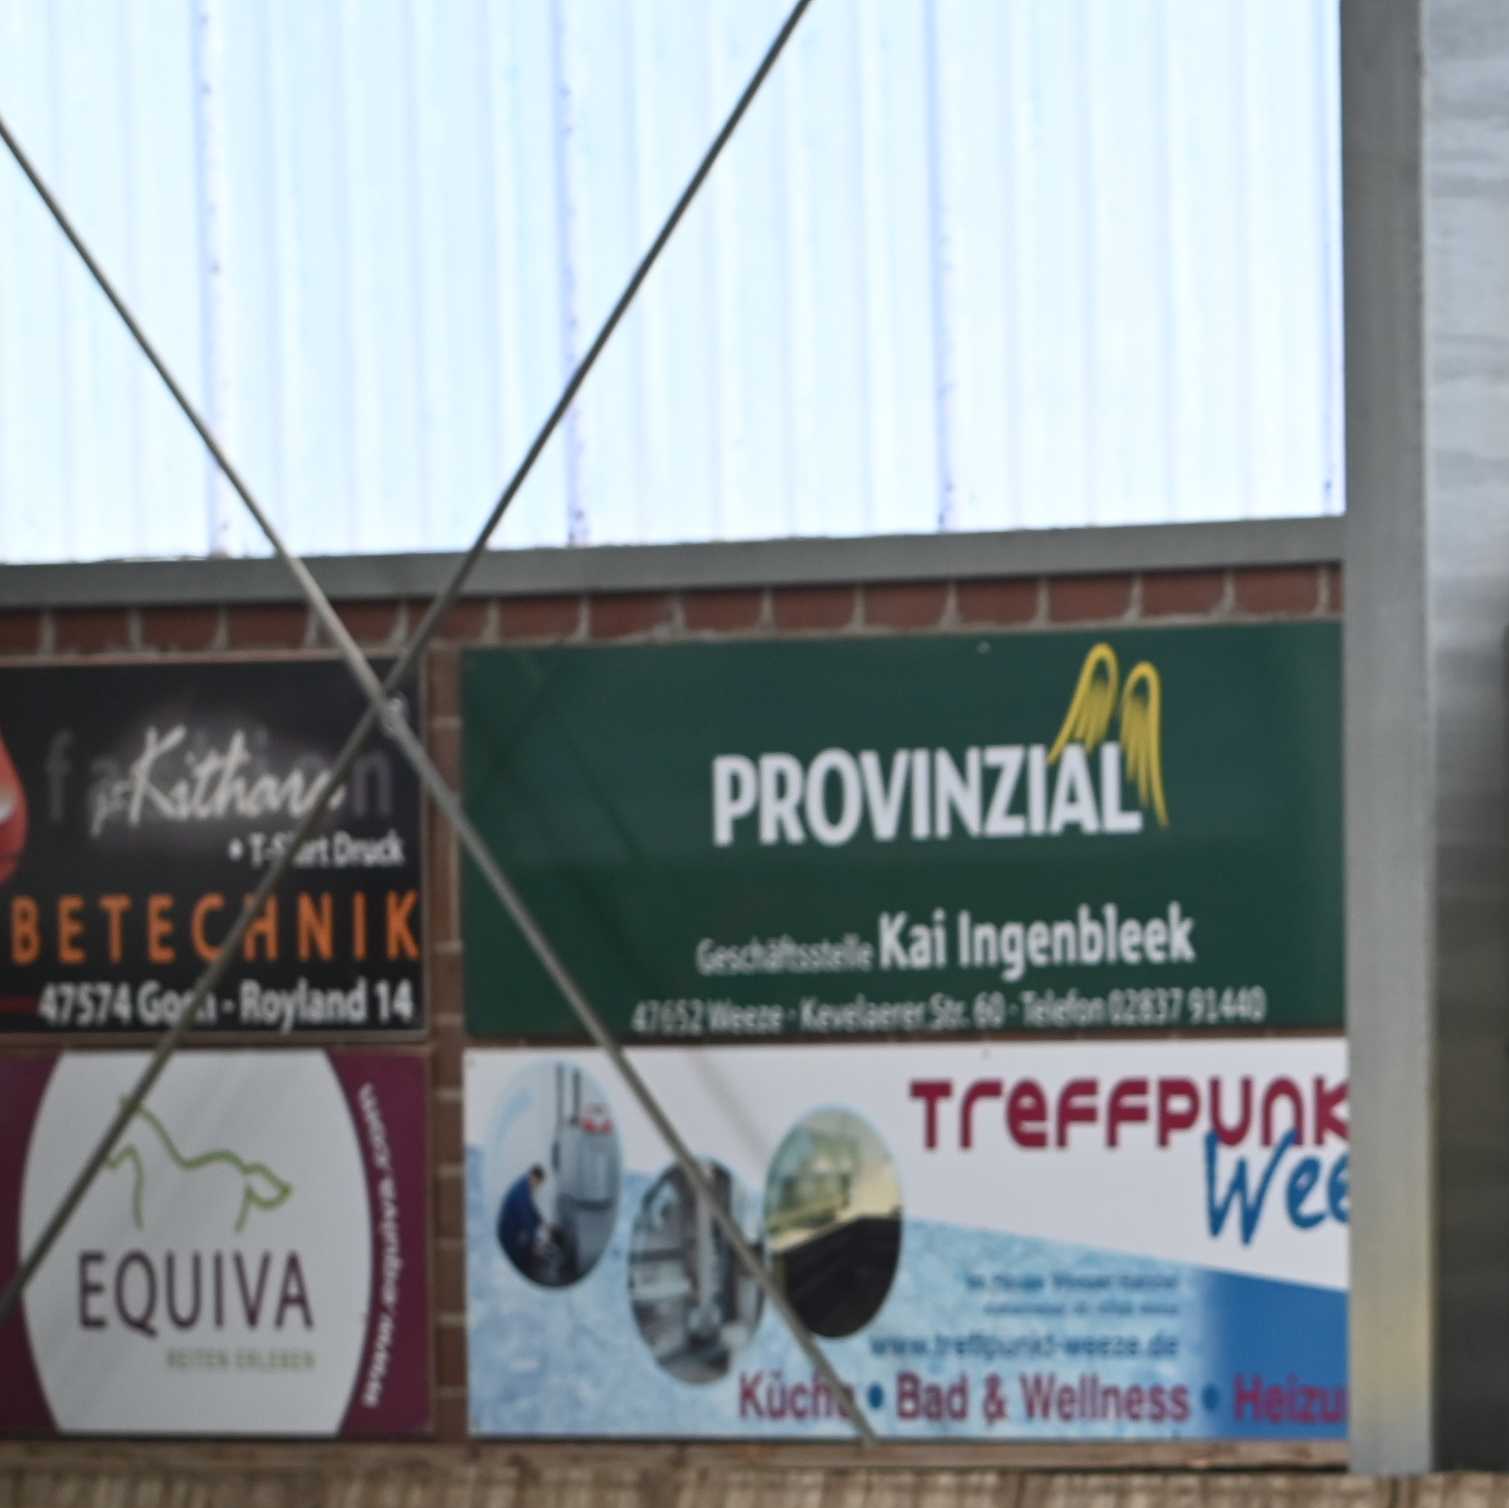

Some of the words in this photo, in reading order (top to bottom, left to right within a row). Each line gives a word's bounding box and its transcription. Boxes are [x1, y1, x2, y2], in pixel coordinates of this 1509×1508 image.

[712, 741, 1142, 848] PROVINZIAL
[10, 889, 421, 966] BETECHNIK
[879, 906, 947, 970] Kai
[958, 900, 1196, 982] Ingenbleek
[239, 976, 368, 1036] Royland
[77, 1249, 315, 1341] EQUIVA
[895, 1371, 969, 1423] Bad
[984, 1374, 1010, 1423] &
[1019, 1371, 1190, 1423] Wellness
